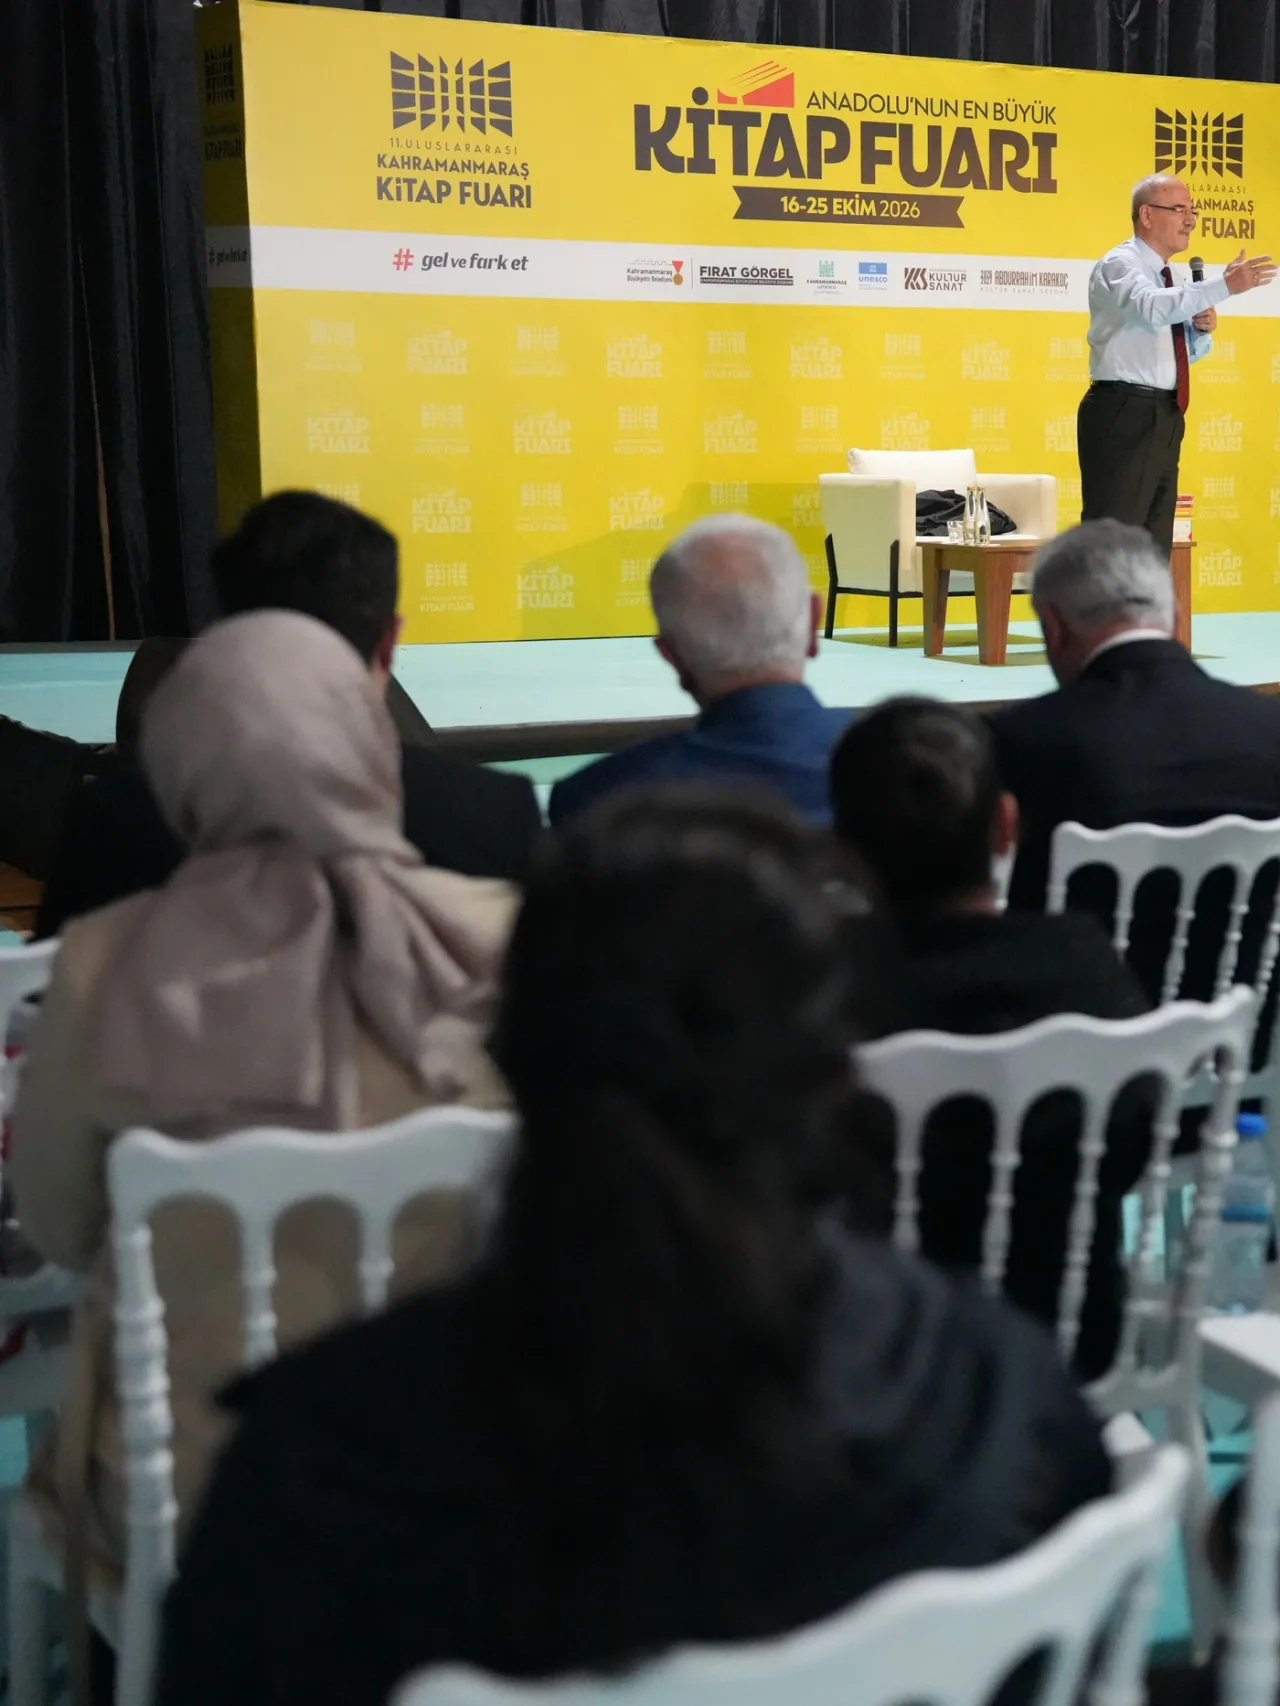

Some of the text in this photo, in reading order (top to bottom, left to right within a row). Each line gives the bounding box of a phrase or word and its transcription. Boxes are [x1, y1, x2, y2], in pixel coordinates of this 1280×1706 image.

[806, 90, 1057, 126] ANADOLU'NUN EN BÜYÜK
[633, 86, 1058, 195] KİTAP FUARI
[376, 153, 530, 181] KAHRAMANMARAŞ
[376, 175, 532, 209] KİTAP FUARI
[780, 193, 920, 219] 16-25 EKİM 2026
[1201, 216, 1255, 240] FUARI
[420, 252, 449, 272] gel
[451, 257, 467, 269] ve
[469, 253, 508, 270] fark
[510, 255, 529, 271] et
[699, 264, 794, 279] FIRAT GÖRGEL
[858, 275, 888, 283] unesco
[928, 281, 964, 292] SANAT
